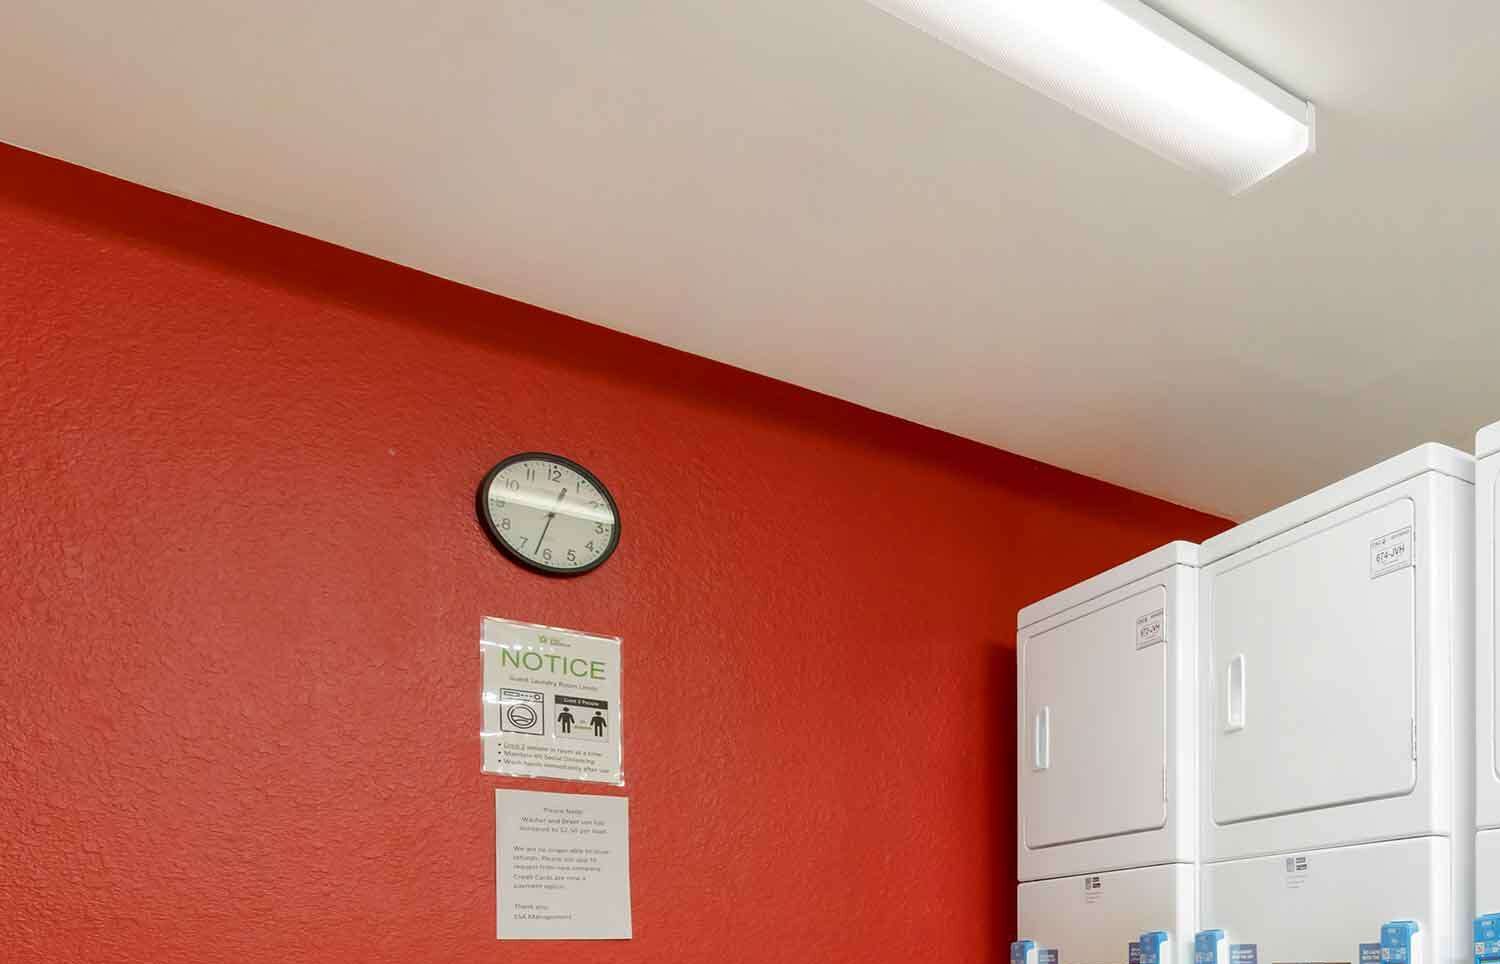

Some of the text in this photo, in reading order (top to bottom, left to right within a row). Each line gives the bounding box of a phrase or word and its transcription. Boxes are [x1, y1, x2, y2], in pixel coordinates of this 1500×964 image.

[525, 467, 536, 481] 11
[547, 467, 562, 484] 12
[504, 478, 520, 491] 10
[501, 518, 511, 530] 8
[594, 521, 604, 535] 3
[519, 536, 529, 549] 7
[584, 541, 594, 552] 4
[542, 548, 552, 560] 6
[566, 549, 576, 562] 5
[501, 648, 607, 680] NOTICE
[531, 678, 557, 687] Laundry
